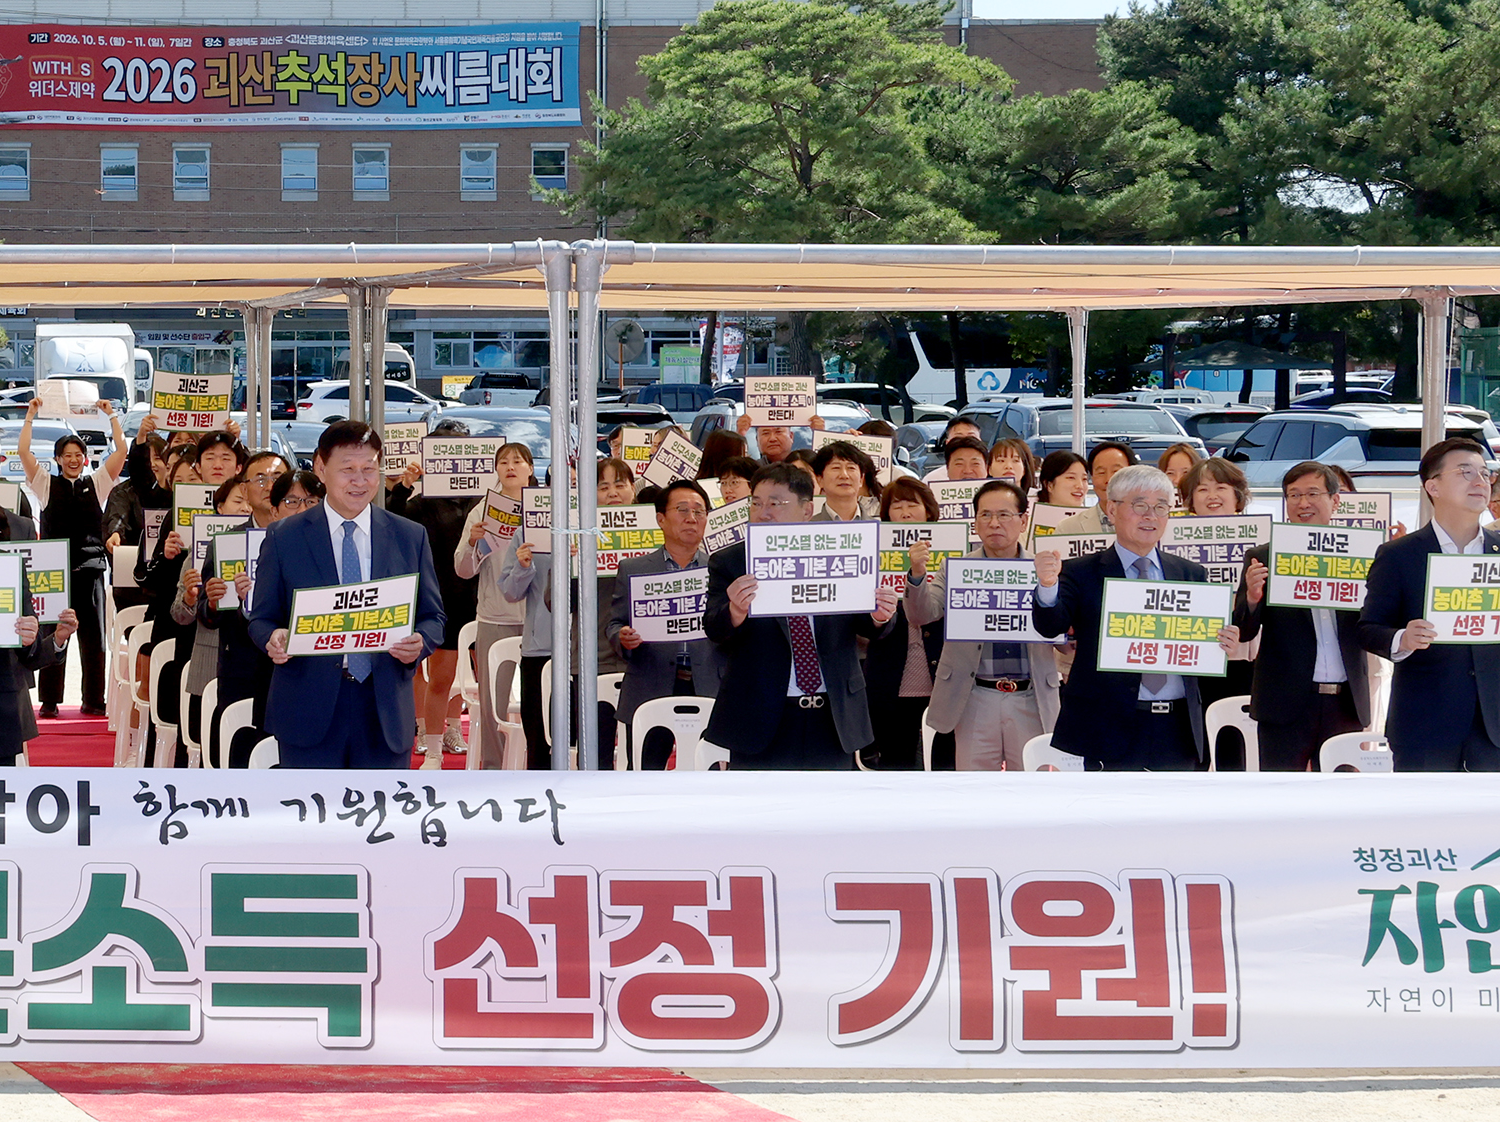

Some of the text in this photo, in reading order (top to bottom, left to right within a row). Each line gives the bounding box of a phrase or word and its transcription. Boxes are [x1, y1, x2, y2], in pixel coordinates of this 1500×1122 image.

[31, 34, 48, 42] 기간
[54, 34, 80, 44] 2026.
[82, 35, 96, 45] 10.
[204, 37, 222, 46] 장소
[260, 36, 283, 46] 괴산군
[102, 56, 197, 103] 2026
[29, 80, 96, 98] 위더스제약
[178, 378, 208, 392] 괴산군
[754, 382, 808, 392] 인구소멸 없는 괴산
[154, 392, 227, 410] 농어촌 기본소득
[747, 394, 814, 407] 농어촌 기본 소득이
[167, 412, 213, 428] 선정 기원!
[391, 428, 419, 439] 없는 괴산
[433, 444, 496, 456] 인구소멸 없는 괴산
[450, 477, 479, 490] 만든다!
[1337, 502, 1377, 514] 없는 괴산
[601, 511, 637, 528] 괴산군
[1174, 525, 1258, 540] 인구소멸 없는 괴산
[766, 533, 861, 552] 인구소멸 없는 괴산
[1308, 532, 1348, 554] 괴산군
[754, 556, 873, 578] 농어촌 기본 소득이
[1276, 554, 1318, 576] 농어촌
[962, 569, 1029, 584] 인구소멸 없는
[644, 578, 703, 596] 인구소멸 없는
[792, 584, 836, 603] 만든다!
[951, 589, 1019, 609] 농어촌 기본
[1144, 588, 1190, 612] 괴산군
[1433, 588, 1484, 611] 농어촌
[297, 604, 409, 634] 농어촌 기본소득
[984, 614, 1027, 632] 만든다!
[1452, 615, 1486, 636] 선정
[313, 632, 386, 650] 선정 기원!
[1127, 642, 1198, 666] 선정 기원!
[132, 780, 251, 845] 함께
[280, 780, 567, 847] 기원합니다
[1352, 847, 1458, 872] 청정괴산
[433, 874, 771, 1041] 선정
[833, 873, 1229, 1043] 기원!
[1366, 986, 1453, 1012] 자연이
